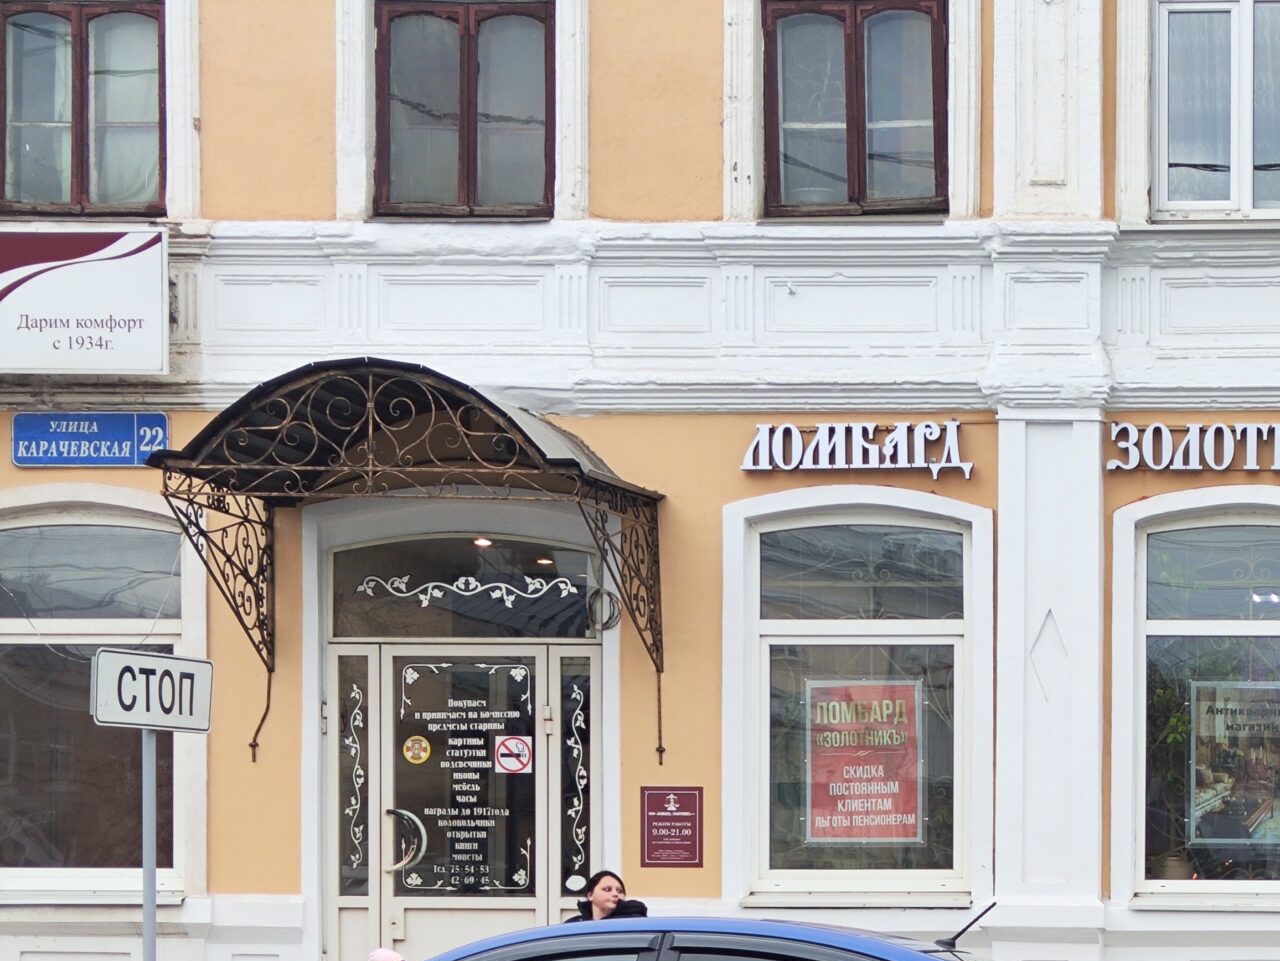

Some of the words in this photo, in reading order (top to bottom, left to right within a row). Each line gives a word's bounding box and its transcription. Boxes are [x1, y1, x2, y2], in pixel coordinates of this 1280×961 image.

[16, 313, 70, 332] Дарим
[76, 313, 145, 333] комфорт
[52, 339, 62, 350] с
[68, 335, 114, 351] 1934г.
[49, 420, 99, 435] УЛИЦА
[139, 426, 165, 452] 22
[17, 439, 133, 458] КАРАЧЕВСКАЯ
[740, 420, 975, 481] ЛОМБАРД
[117, 665, 195, 717] СТОП
[448, 698, 487, 709] Покупаем
[414, 711, 421, 720] и
[422, 711, 466, 721] принимаем
[468, 711, 478, 719] на
[480, 710, 521, 719] комиссию
[815, 699, 908, 725] ЛОМБАРД
[428, 723, 468, 732] предметы
[470, 722, 505, 732] старины
[1226, 722, 1280, 733] магазин
[448, 737, 484, 747] картины
[816, 729, 908, 748] «ЗОЛОТНИКЪ»
[446, 749, 487, 759] статуэтки
[440, 761, 493, 769] подсвечники
[453, 772, 480, 780] иконы
[843, 764, 885, 779] СКИДКА
[452, 783, 481, 791] мебель
[829, 781, 899, 796] ПОСТОЯННЫМ
[456, 795, 477, 803] часы
[837, 798, 892, 812] КЛИЕНТАМ
[424, 807, 459, 817] награды
[461, 808, 471, 816] до
[438, 819, 496, 827] колокольчики
[815, 815, 850, 828] ЛЬГОТЫ
[852, 813, 916, 827] ПЕНСИОНЕРАМ
[446, 831, 487, 840] открытки
[455, 842, 479, 850] книги
[452, 853, 483, 862] монеты
